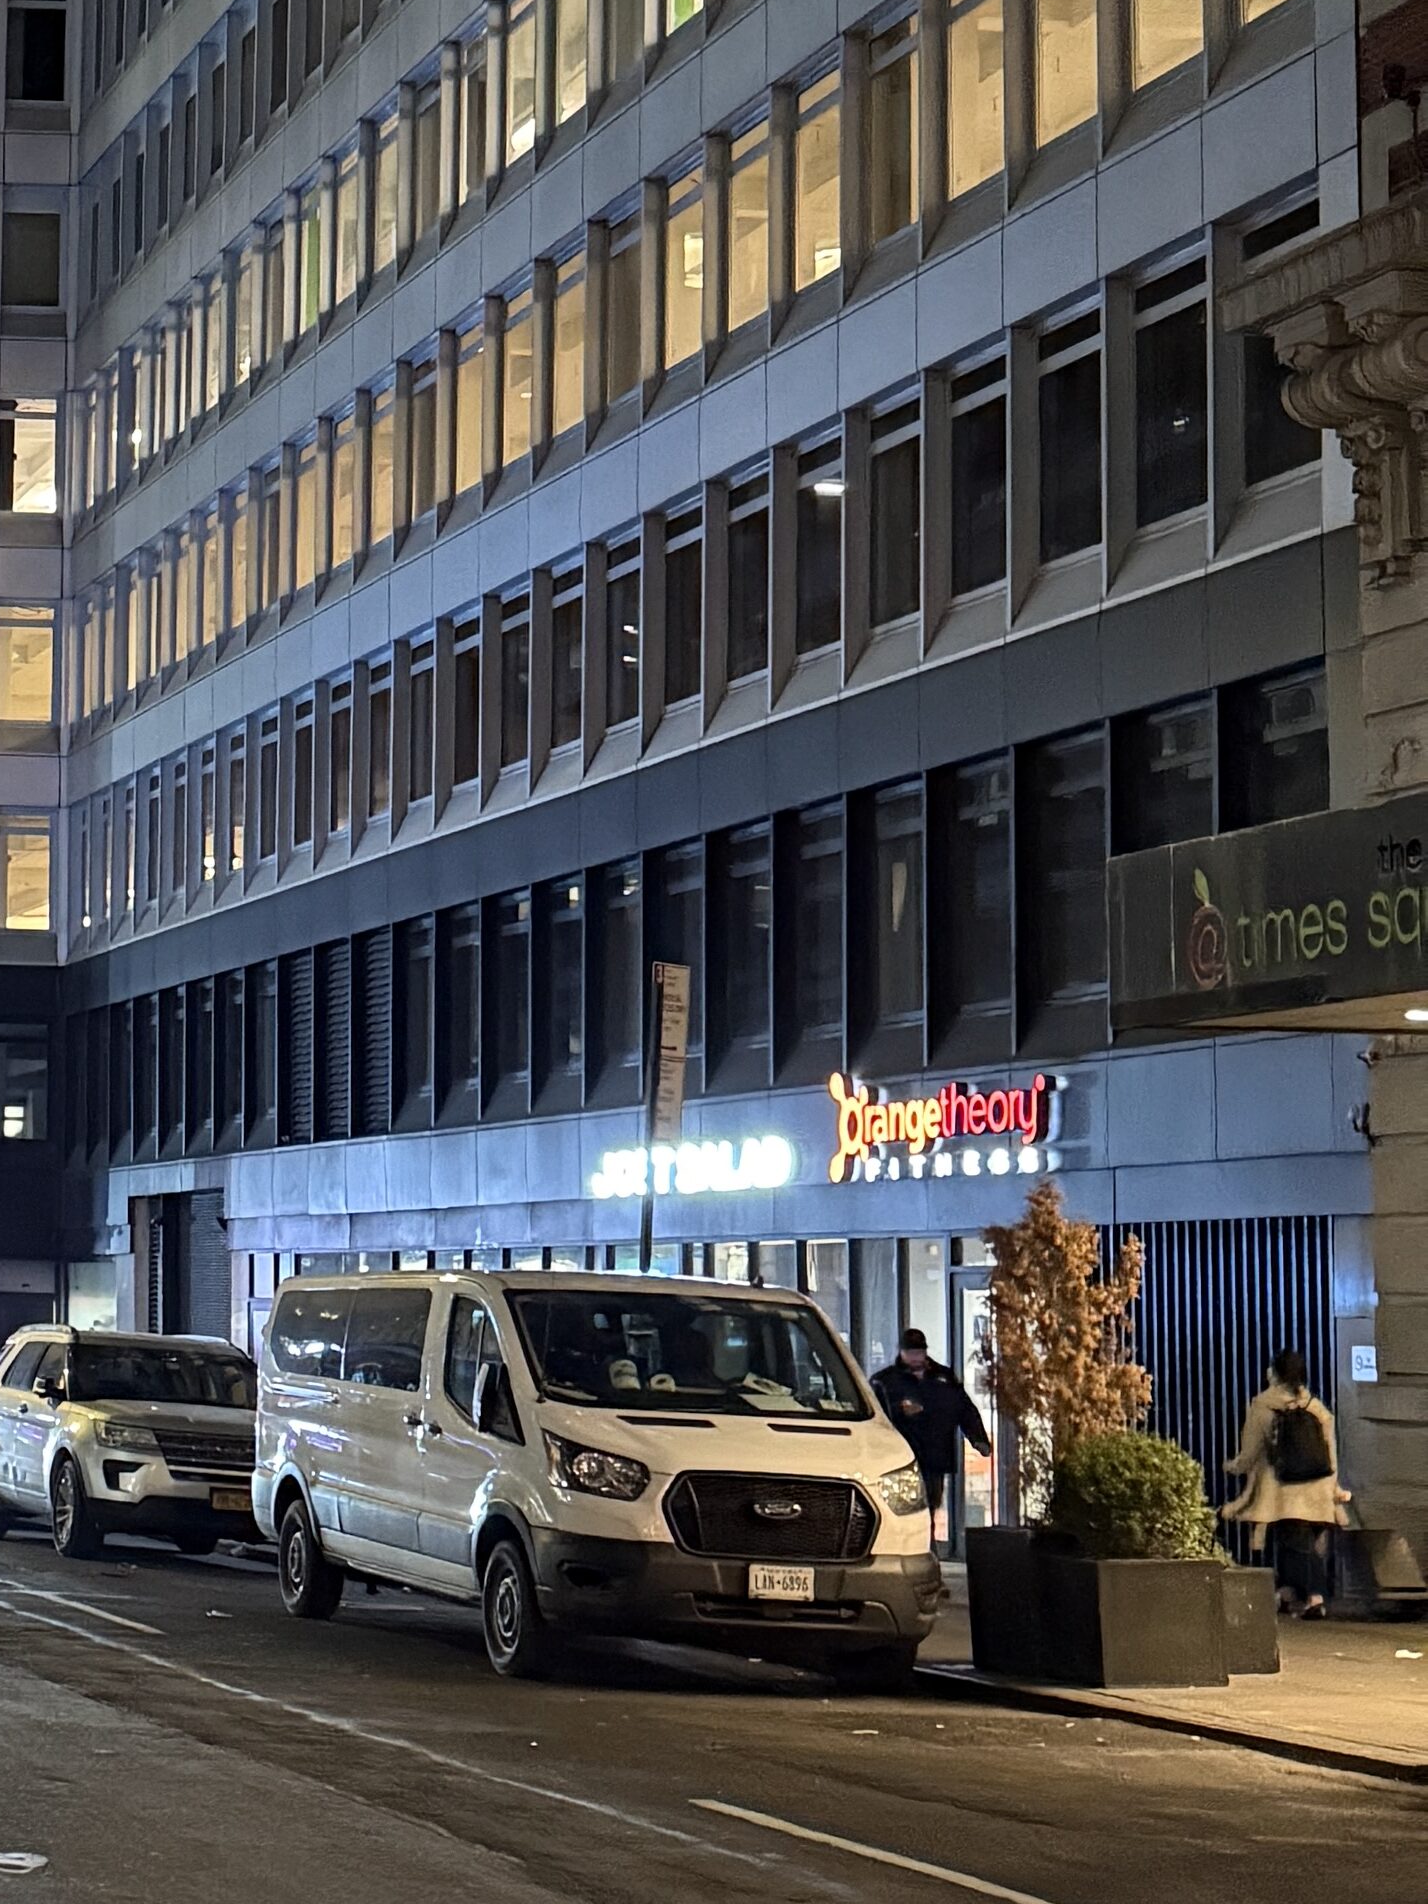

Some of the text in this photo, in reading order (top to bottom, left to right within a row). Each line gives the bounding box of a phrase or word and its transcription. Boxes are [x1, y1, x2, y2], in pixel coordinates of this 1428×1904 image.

[1377, 834, 1423, 873] the
[1368, 883, 1428, 962] sq
[865, 1146, 1040, 1182] FITNESS
